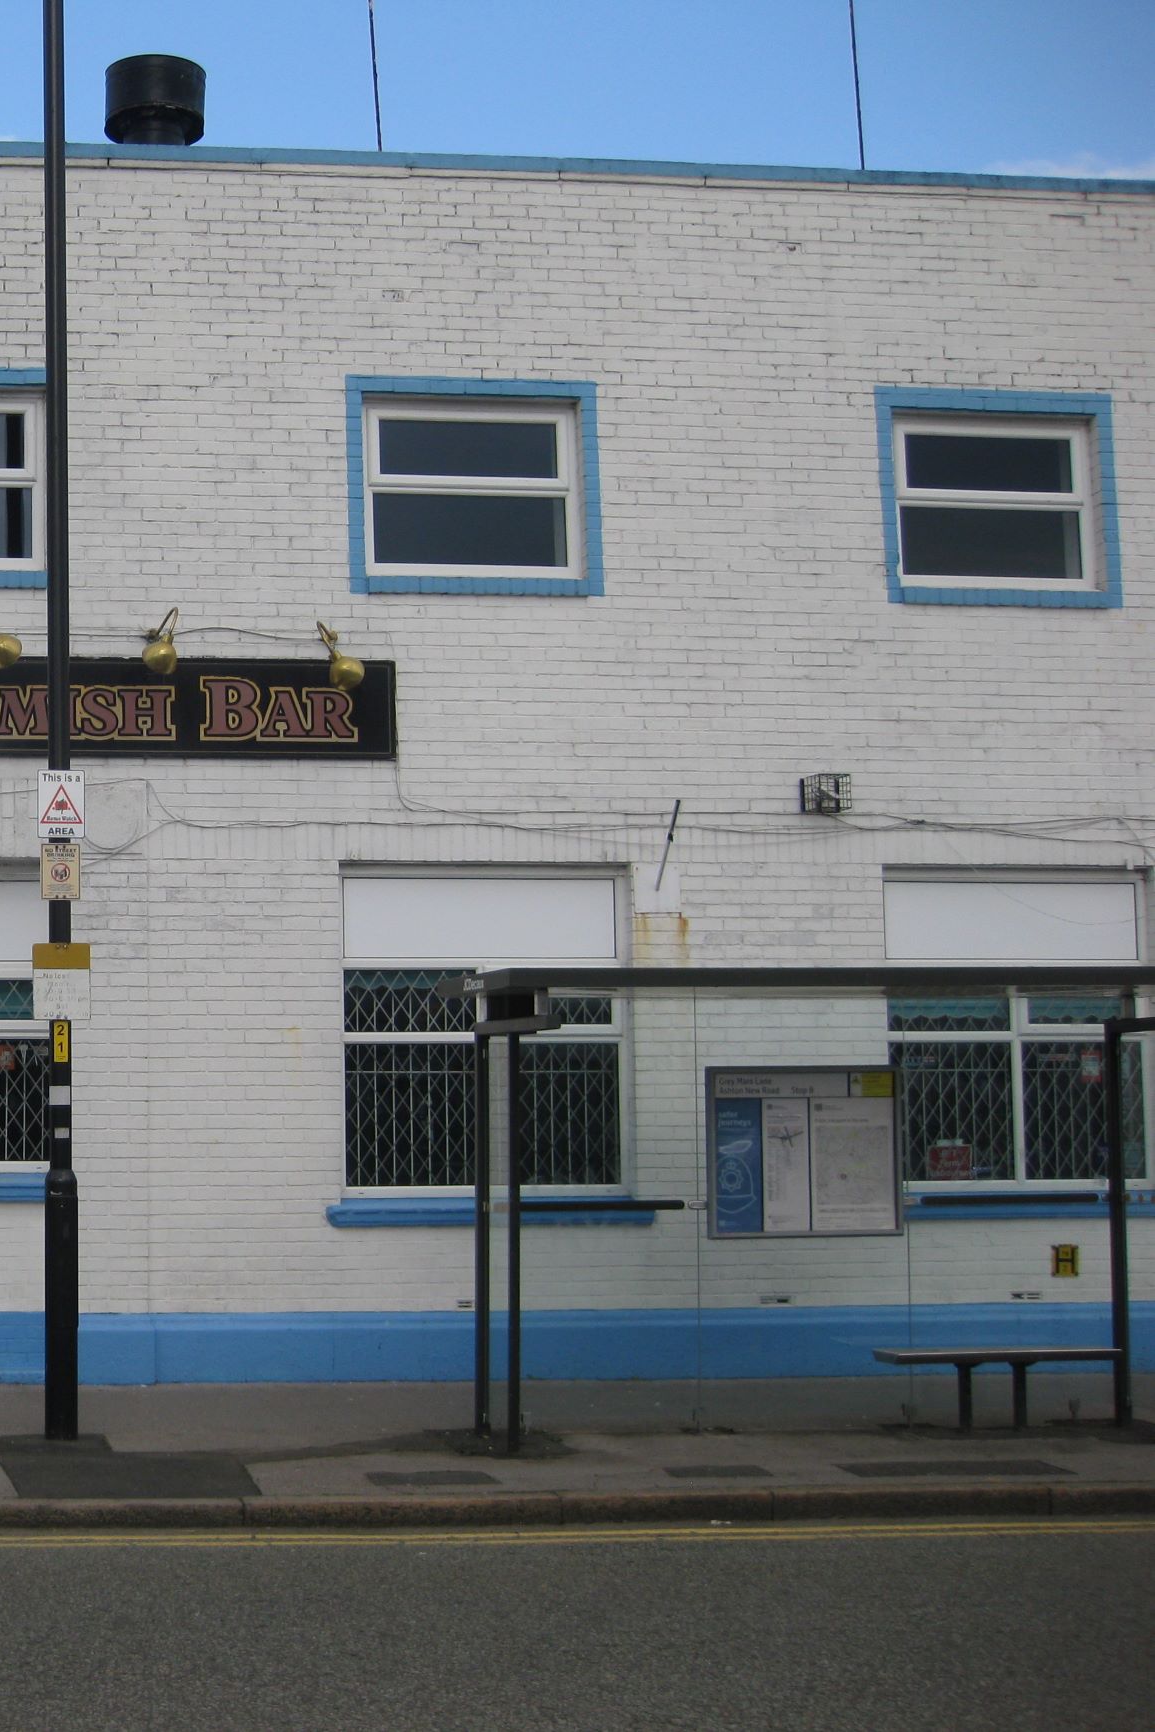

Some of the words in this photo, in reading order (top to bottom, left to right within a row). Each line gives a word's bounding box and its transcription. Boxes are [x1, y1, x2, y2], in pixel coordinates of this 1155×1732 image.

[199, 675, 359, 743] BAR
[42, 773, 62, 783] This
[64, 773, 73, 783] is
[75, 775, 81, 783] a
